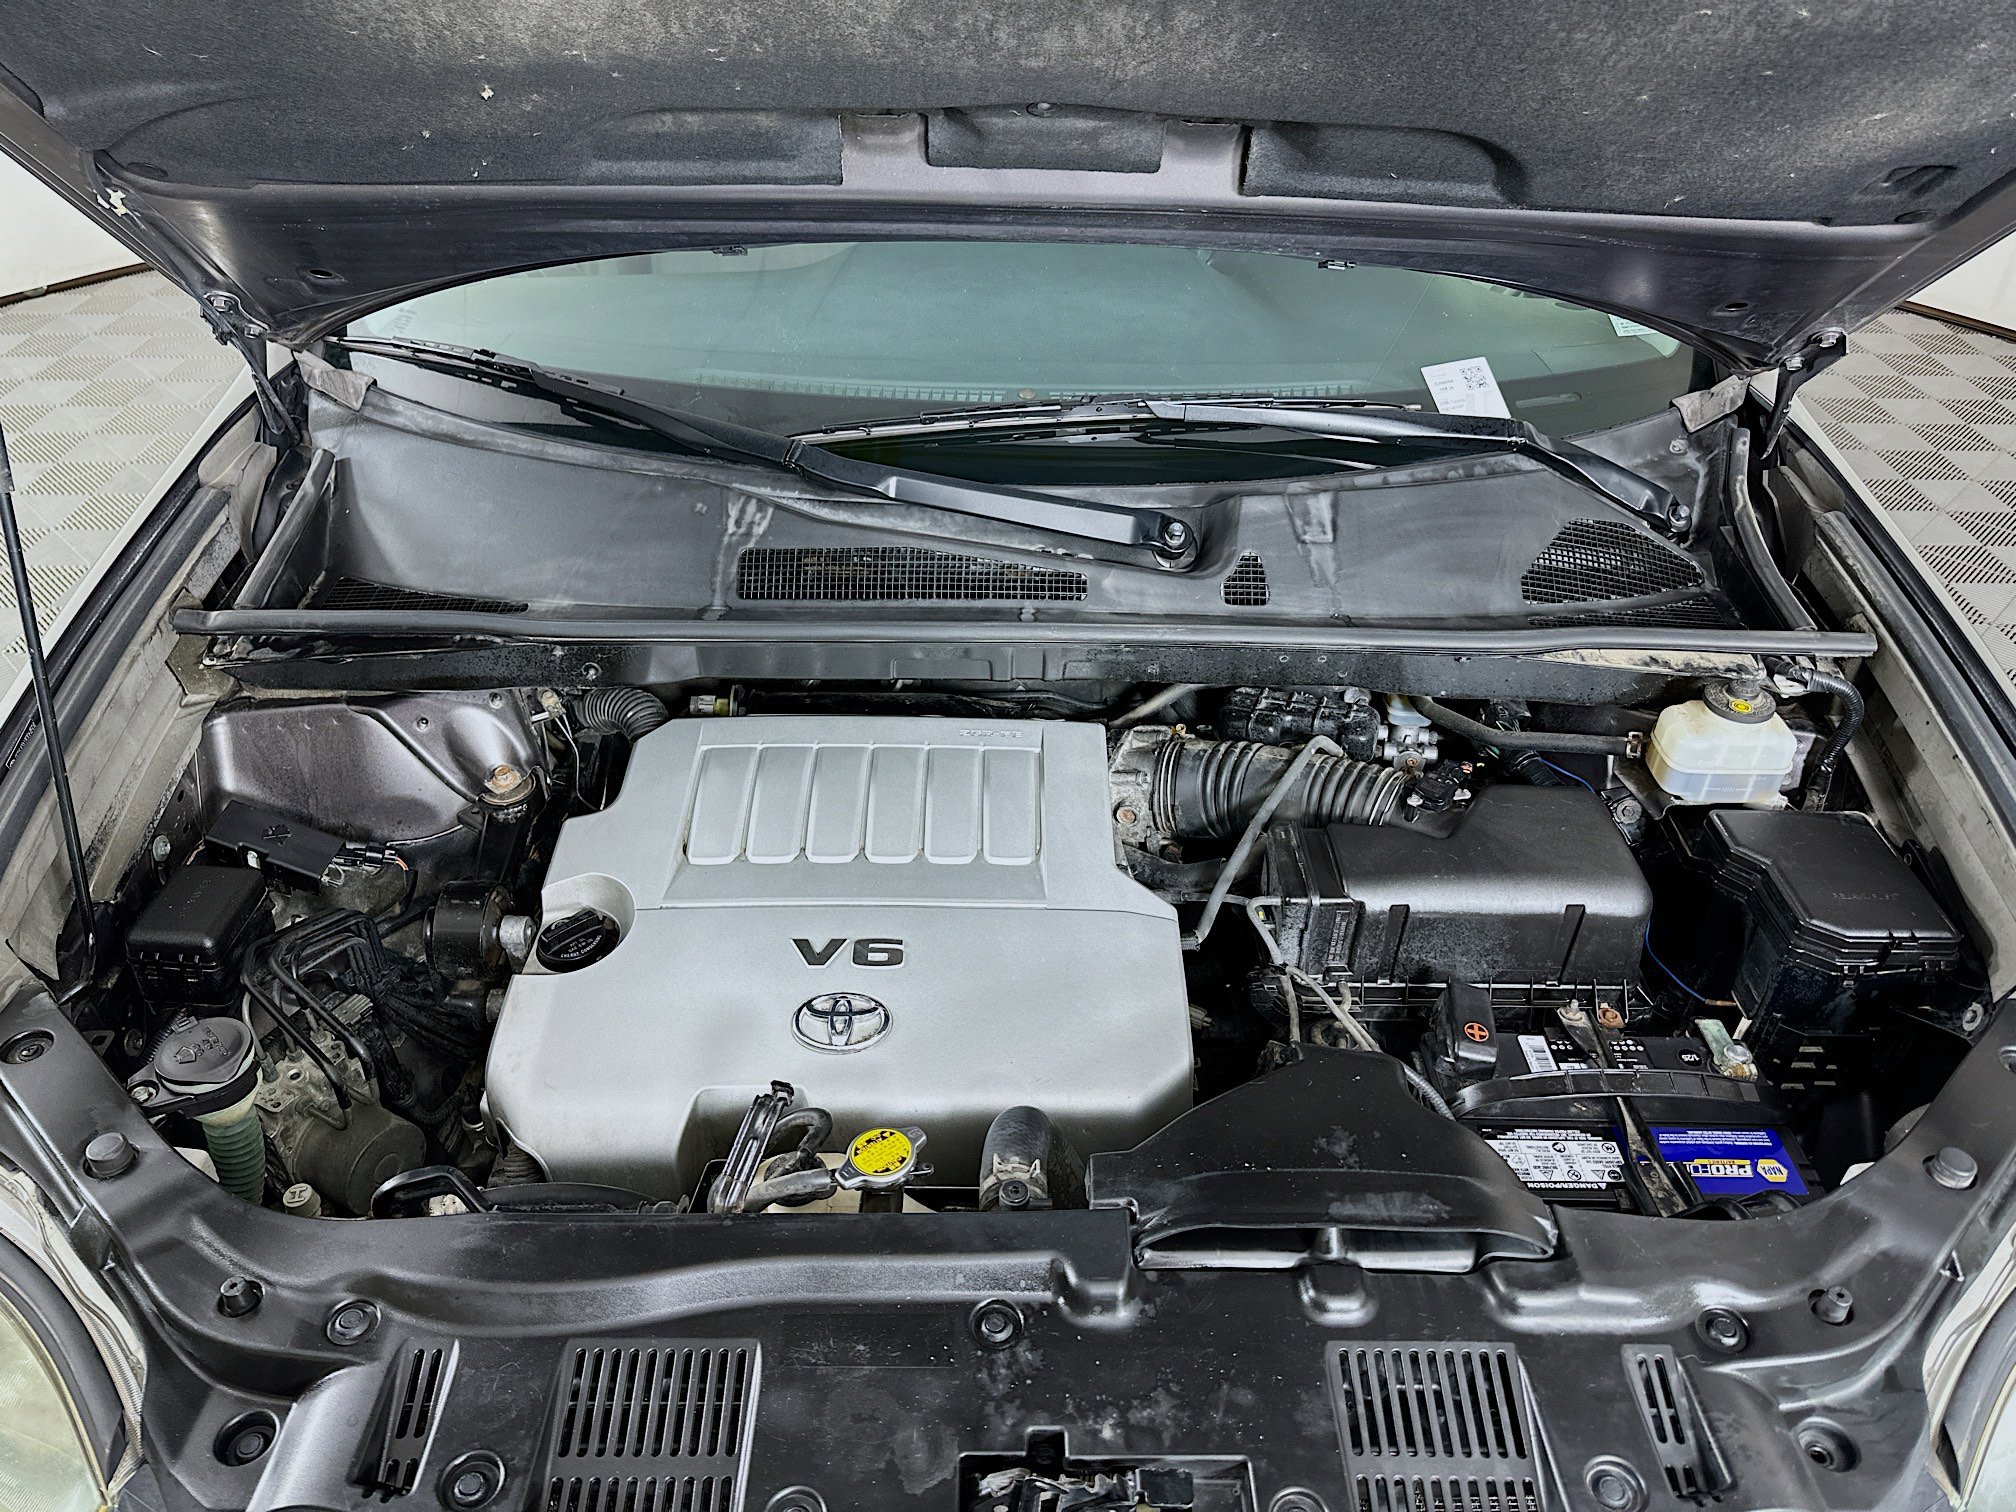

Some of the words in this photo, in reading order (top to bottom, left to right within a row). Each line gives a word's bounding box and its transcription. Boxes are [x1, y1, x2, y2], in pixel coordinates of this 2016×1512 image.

[790, 937, 905, 969] V6
[1685, 1163, 1753, 1176] PROFO
[1760, 1165, 1784, 1176] NAPA
[1527, 1182, 1599, 1190] DANGER/POISON
